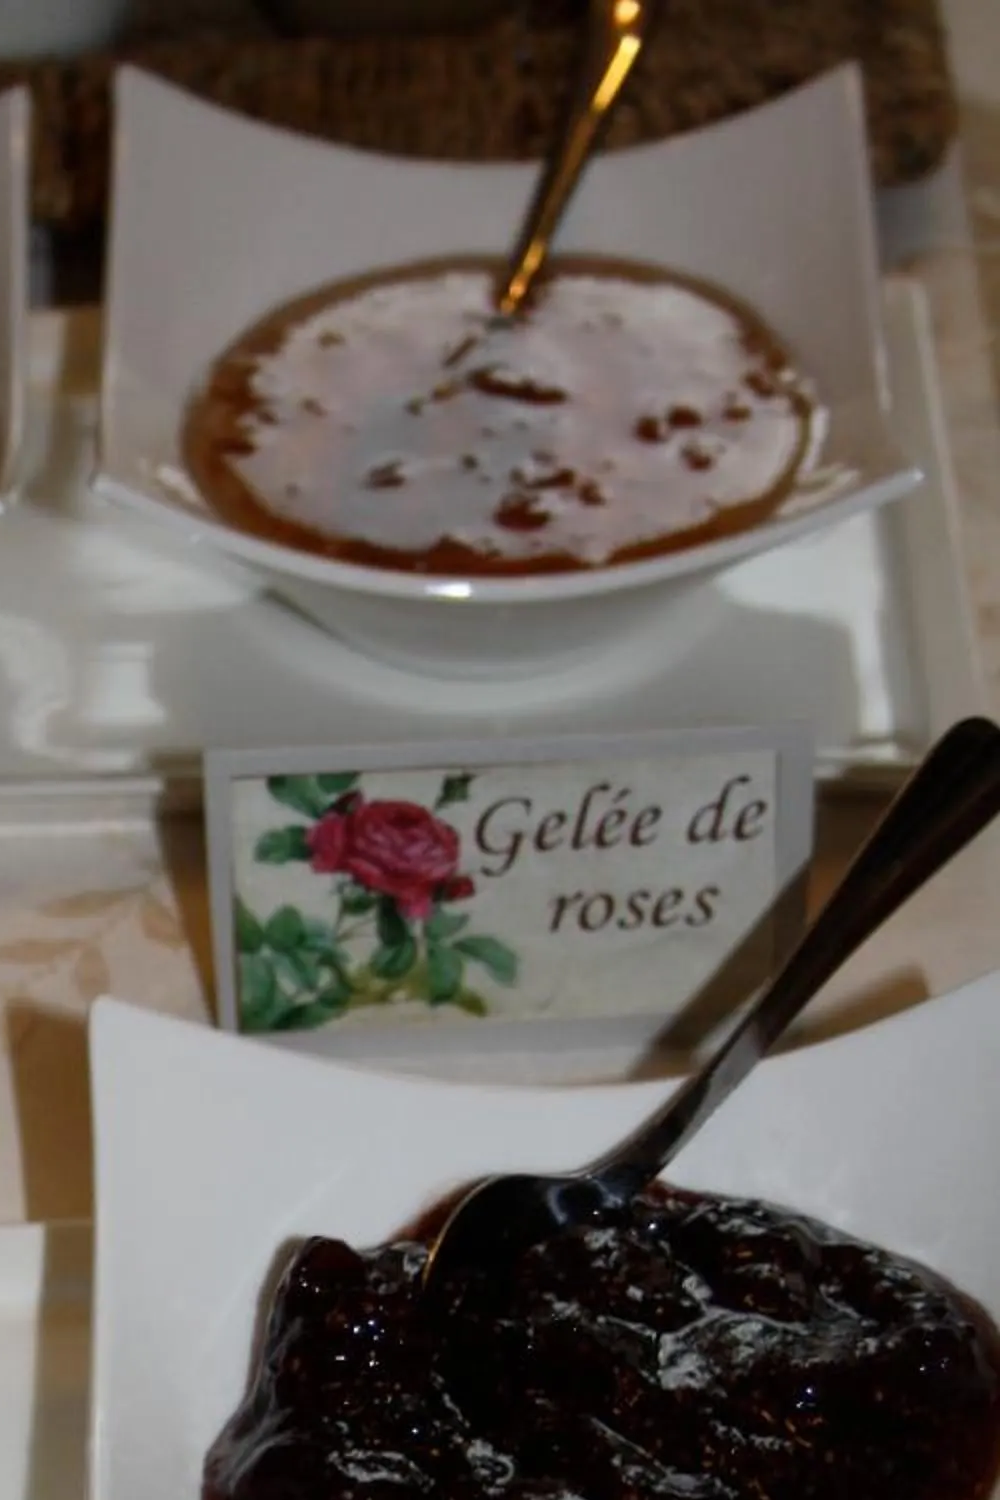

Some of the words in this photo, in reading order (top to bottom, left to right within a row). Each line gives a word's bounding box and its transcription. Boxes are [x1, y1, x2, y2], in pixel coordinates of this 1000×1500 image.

[474, 781, 663, 876] Gelée
[687, 774, 767, 842] de
[549, 884, 721, 933] roses
